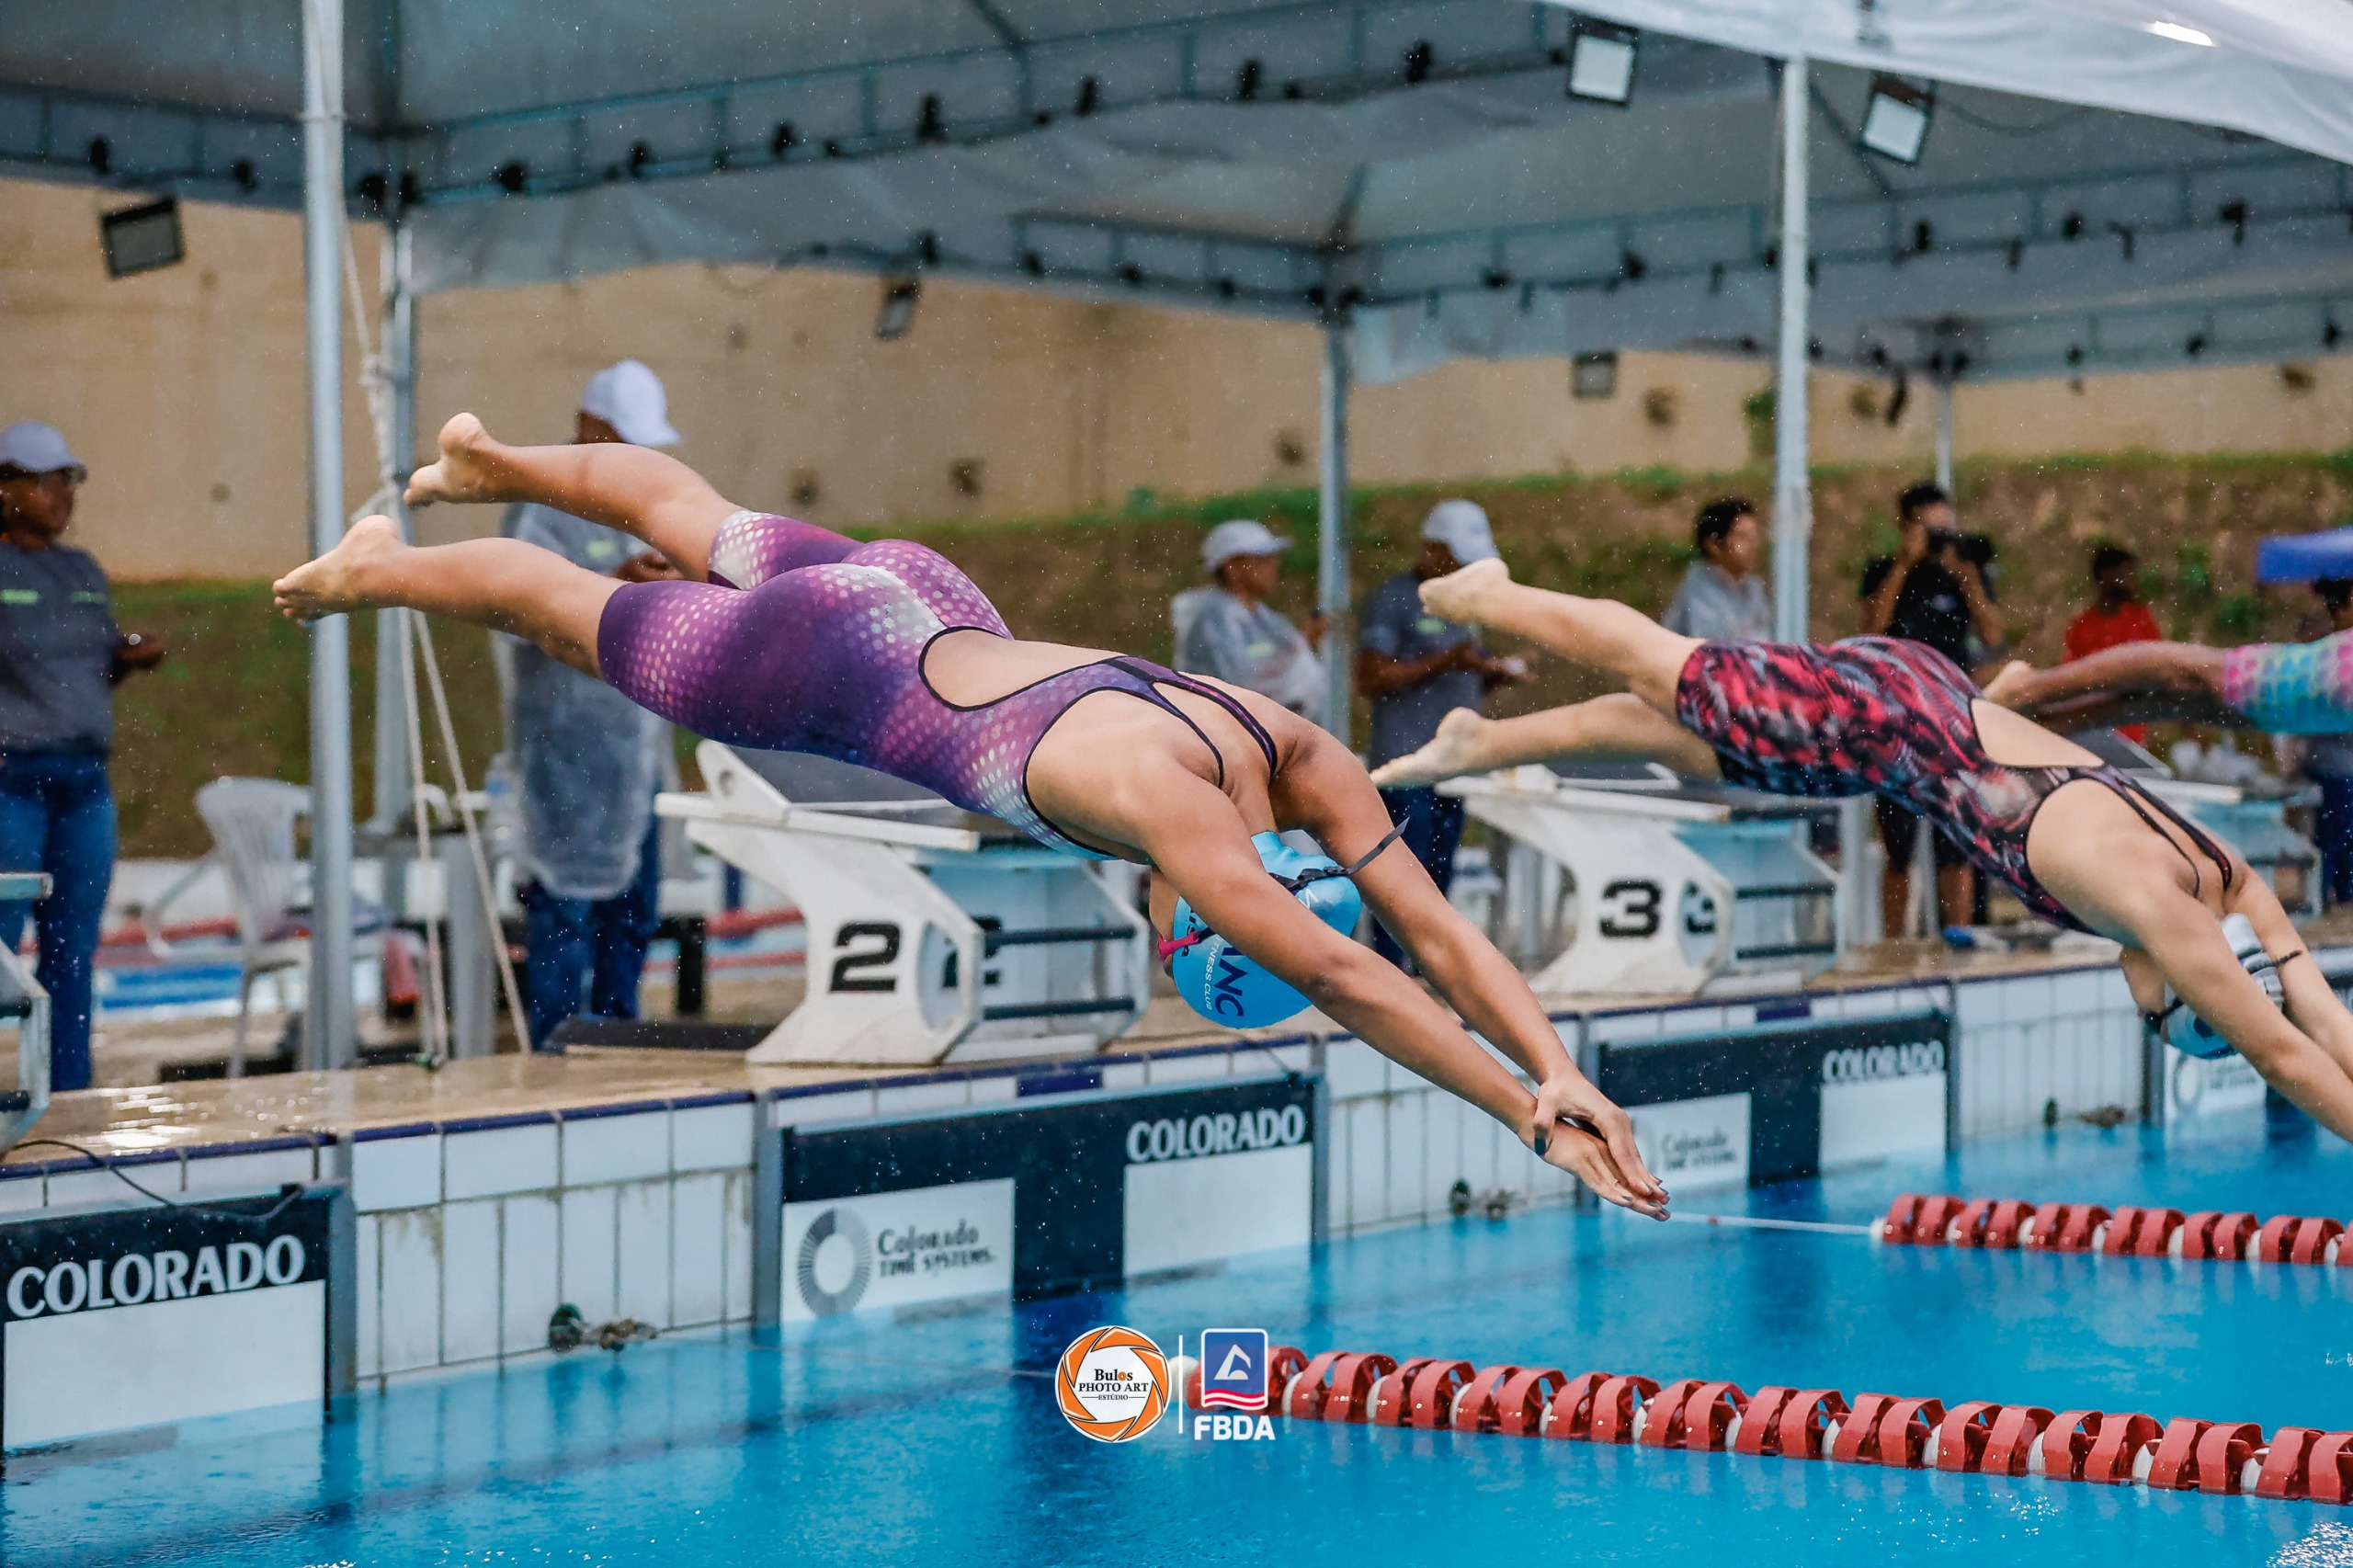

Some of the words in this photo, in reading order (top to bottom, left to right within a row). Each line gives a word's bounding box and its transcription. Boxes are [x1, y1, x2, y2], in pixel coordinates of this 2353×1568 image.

[1599, 879, 1662, 938] 3
[830, 923, 900, 992] 2
[1125, 1103, 1307, 1163] COLORADO
[6, 1233, 306, 1319] COLORADO
